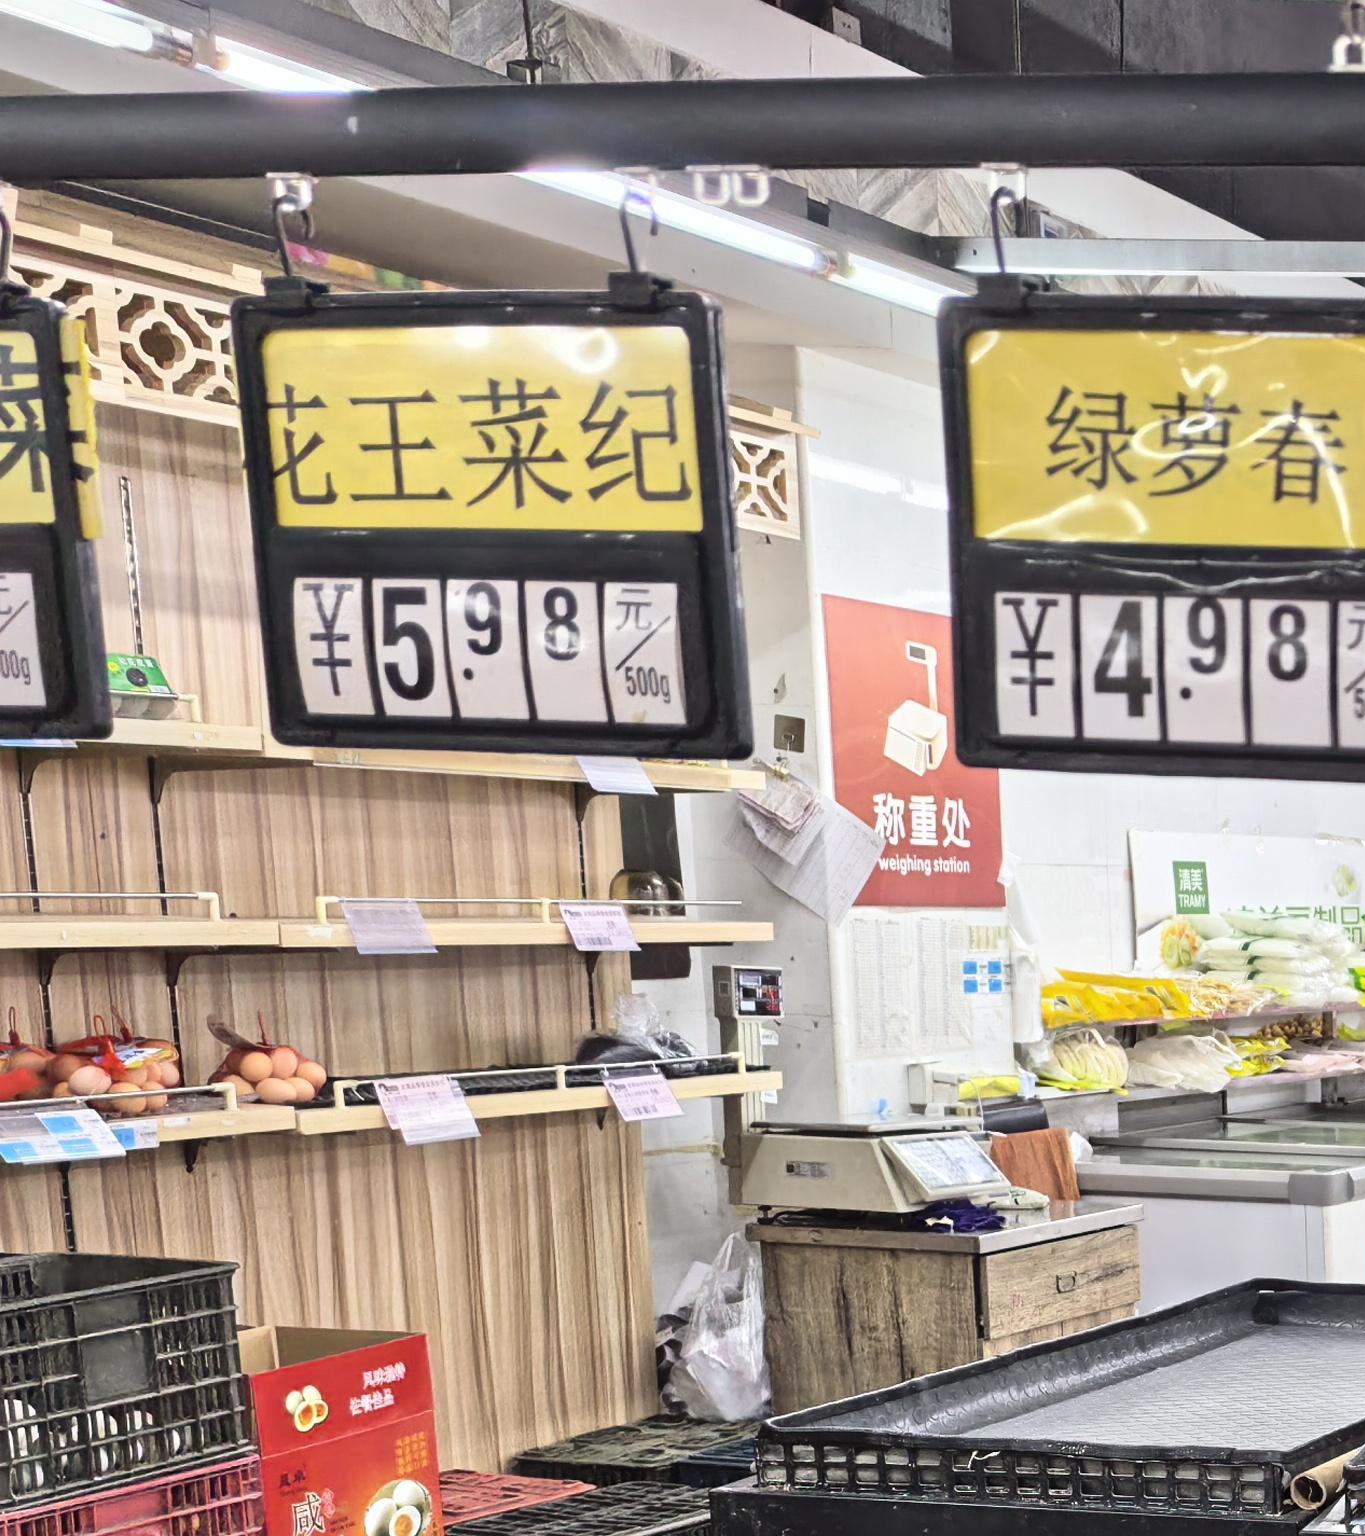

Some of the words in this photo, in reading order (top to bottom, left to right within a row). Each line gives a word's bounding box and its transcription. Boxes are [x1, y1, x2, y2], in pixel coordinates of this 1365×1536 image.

[1045, 384, 1347, 507] 绿萝春
[302, 582, 581, 701] ¥5.98
[1002, 599, 1307, 719] ¥4.98
[873, 792, 972, 848] 称重处
[879, 855, 932, 876] weighing
[933, 856, 971, 874] station
[1178, 868, 1204, 892] 清美
[1178, 894, 1206, 909] TRAMY
